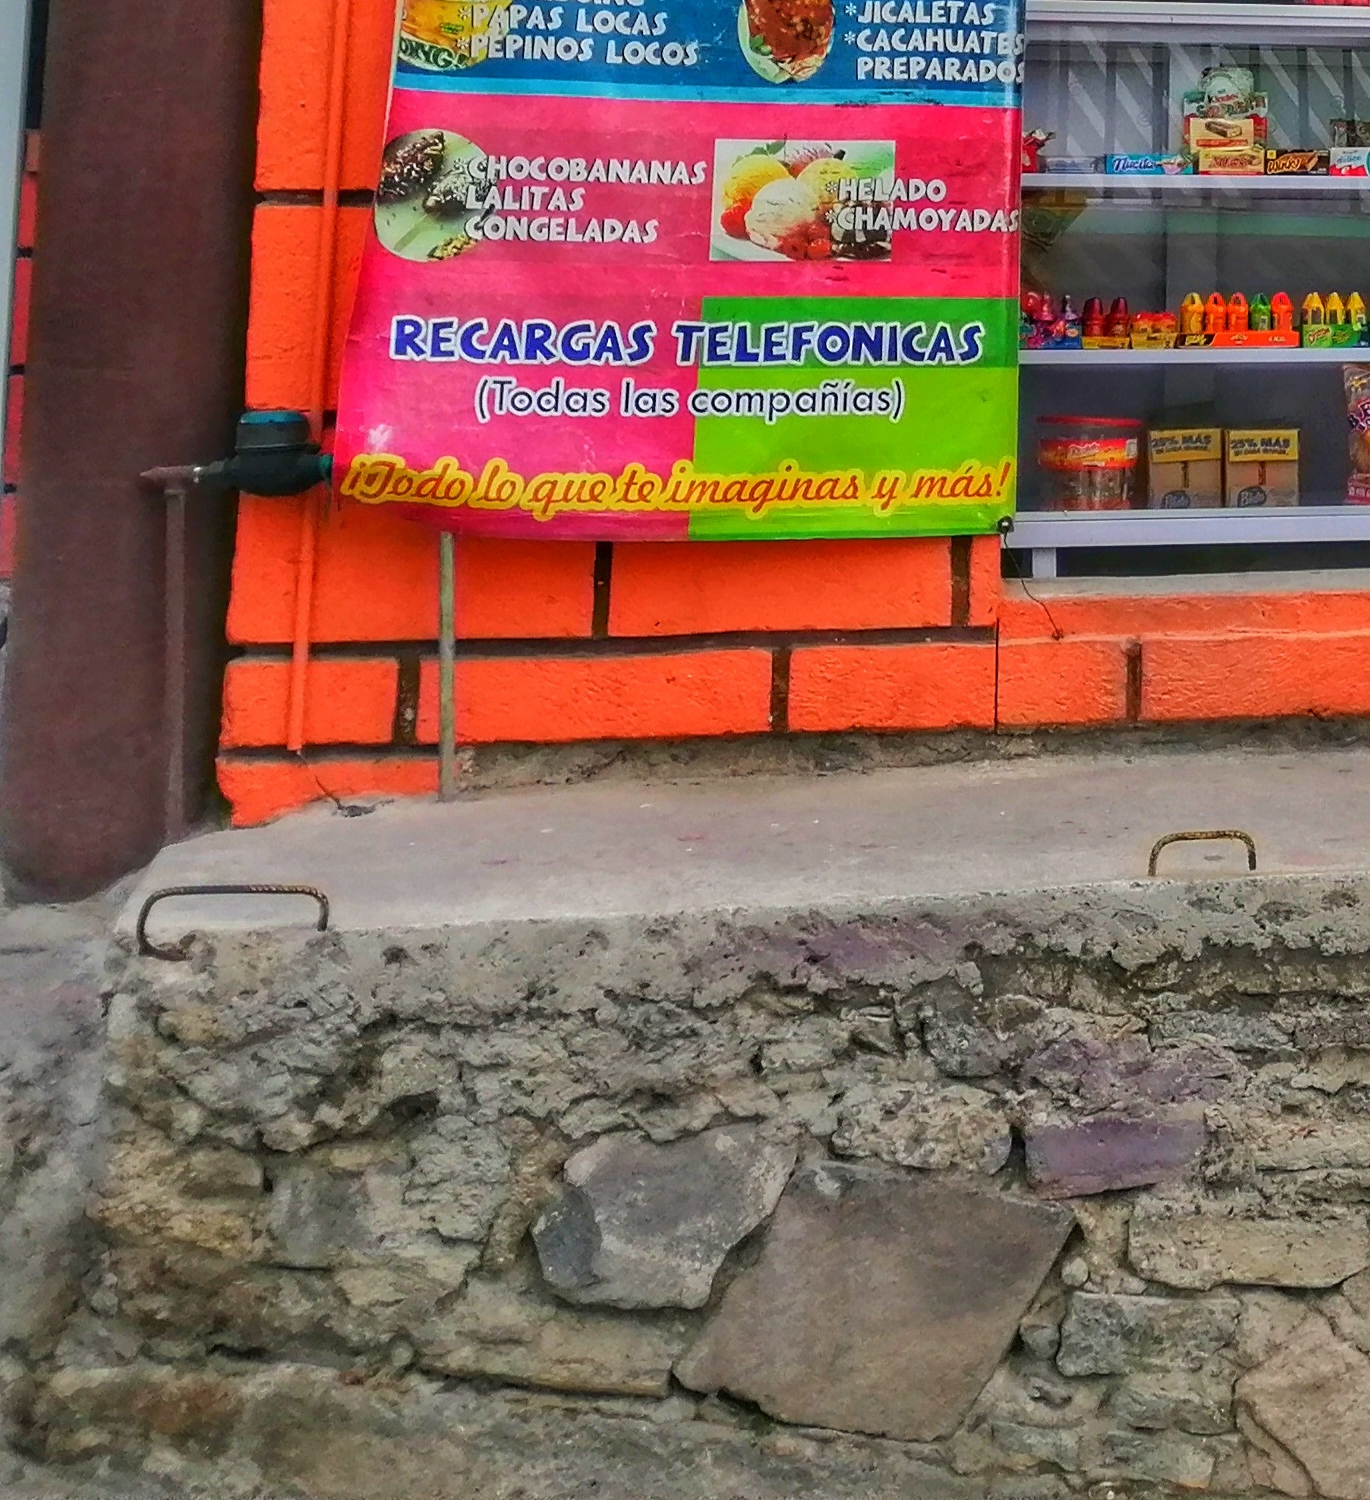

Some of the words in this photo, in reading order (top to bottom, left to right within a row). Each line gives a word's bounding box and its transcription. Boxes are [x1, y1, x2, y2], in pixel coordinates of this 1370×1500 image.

[471, 3, 564, 31] PAPAS
[577, 8, 668, 36] LOCAS
[856, 0, 996, 26] JICALETAS
[470, 34, 594, 62] PEPINOS
[606, 40, 699, 66] LOCOS
[855, 28, 1025, 56] CACAHUATES
[467, 155, 708, 186] CHOCOBANANAS
[465, 185, 586, 212] LALITAS
[838, 177, 947, 203] HELADO
[464, 215, 659, 244] CONGELADAS
[837, 206, 1019, 233] CHAMOYADAS
[390, 315, 657, 367] RECARGAS
[673, 320, 985, 367] TELEFONICAS
[475, 375, 610, 423] (Todas
[620, 377, 680, 417] las
[688, 377, 906, 426] compañías)
[476, 461, 521, 505] lo
[527, 474, 610, 517] que
[616, 466, 658, 507] te
[668, 462, 861, 515] imaginas
[872, 472, 902, 512] y
[911, 458, 1015, 502] más!
